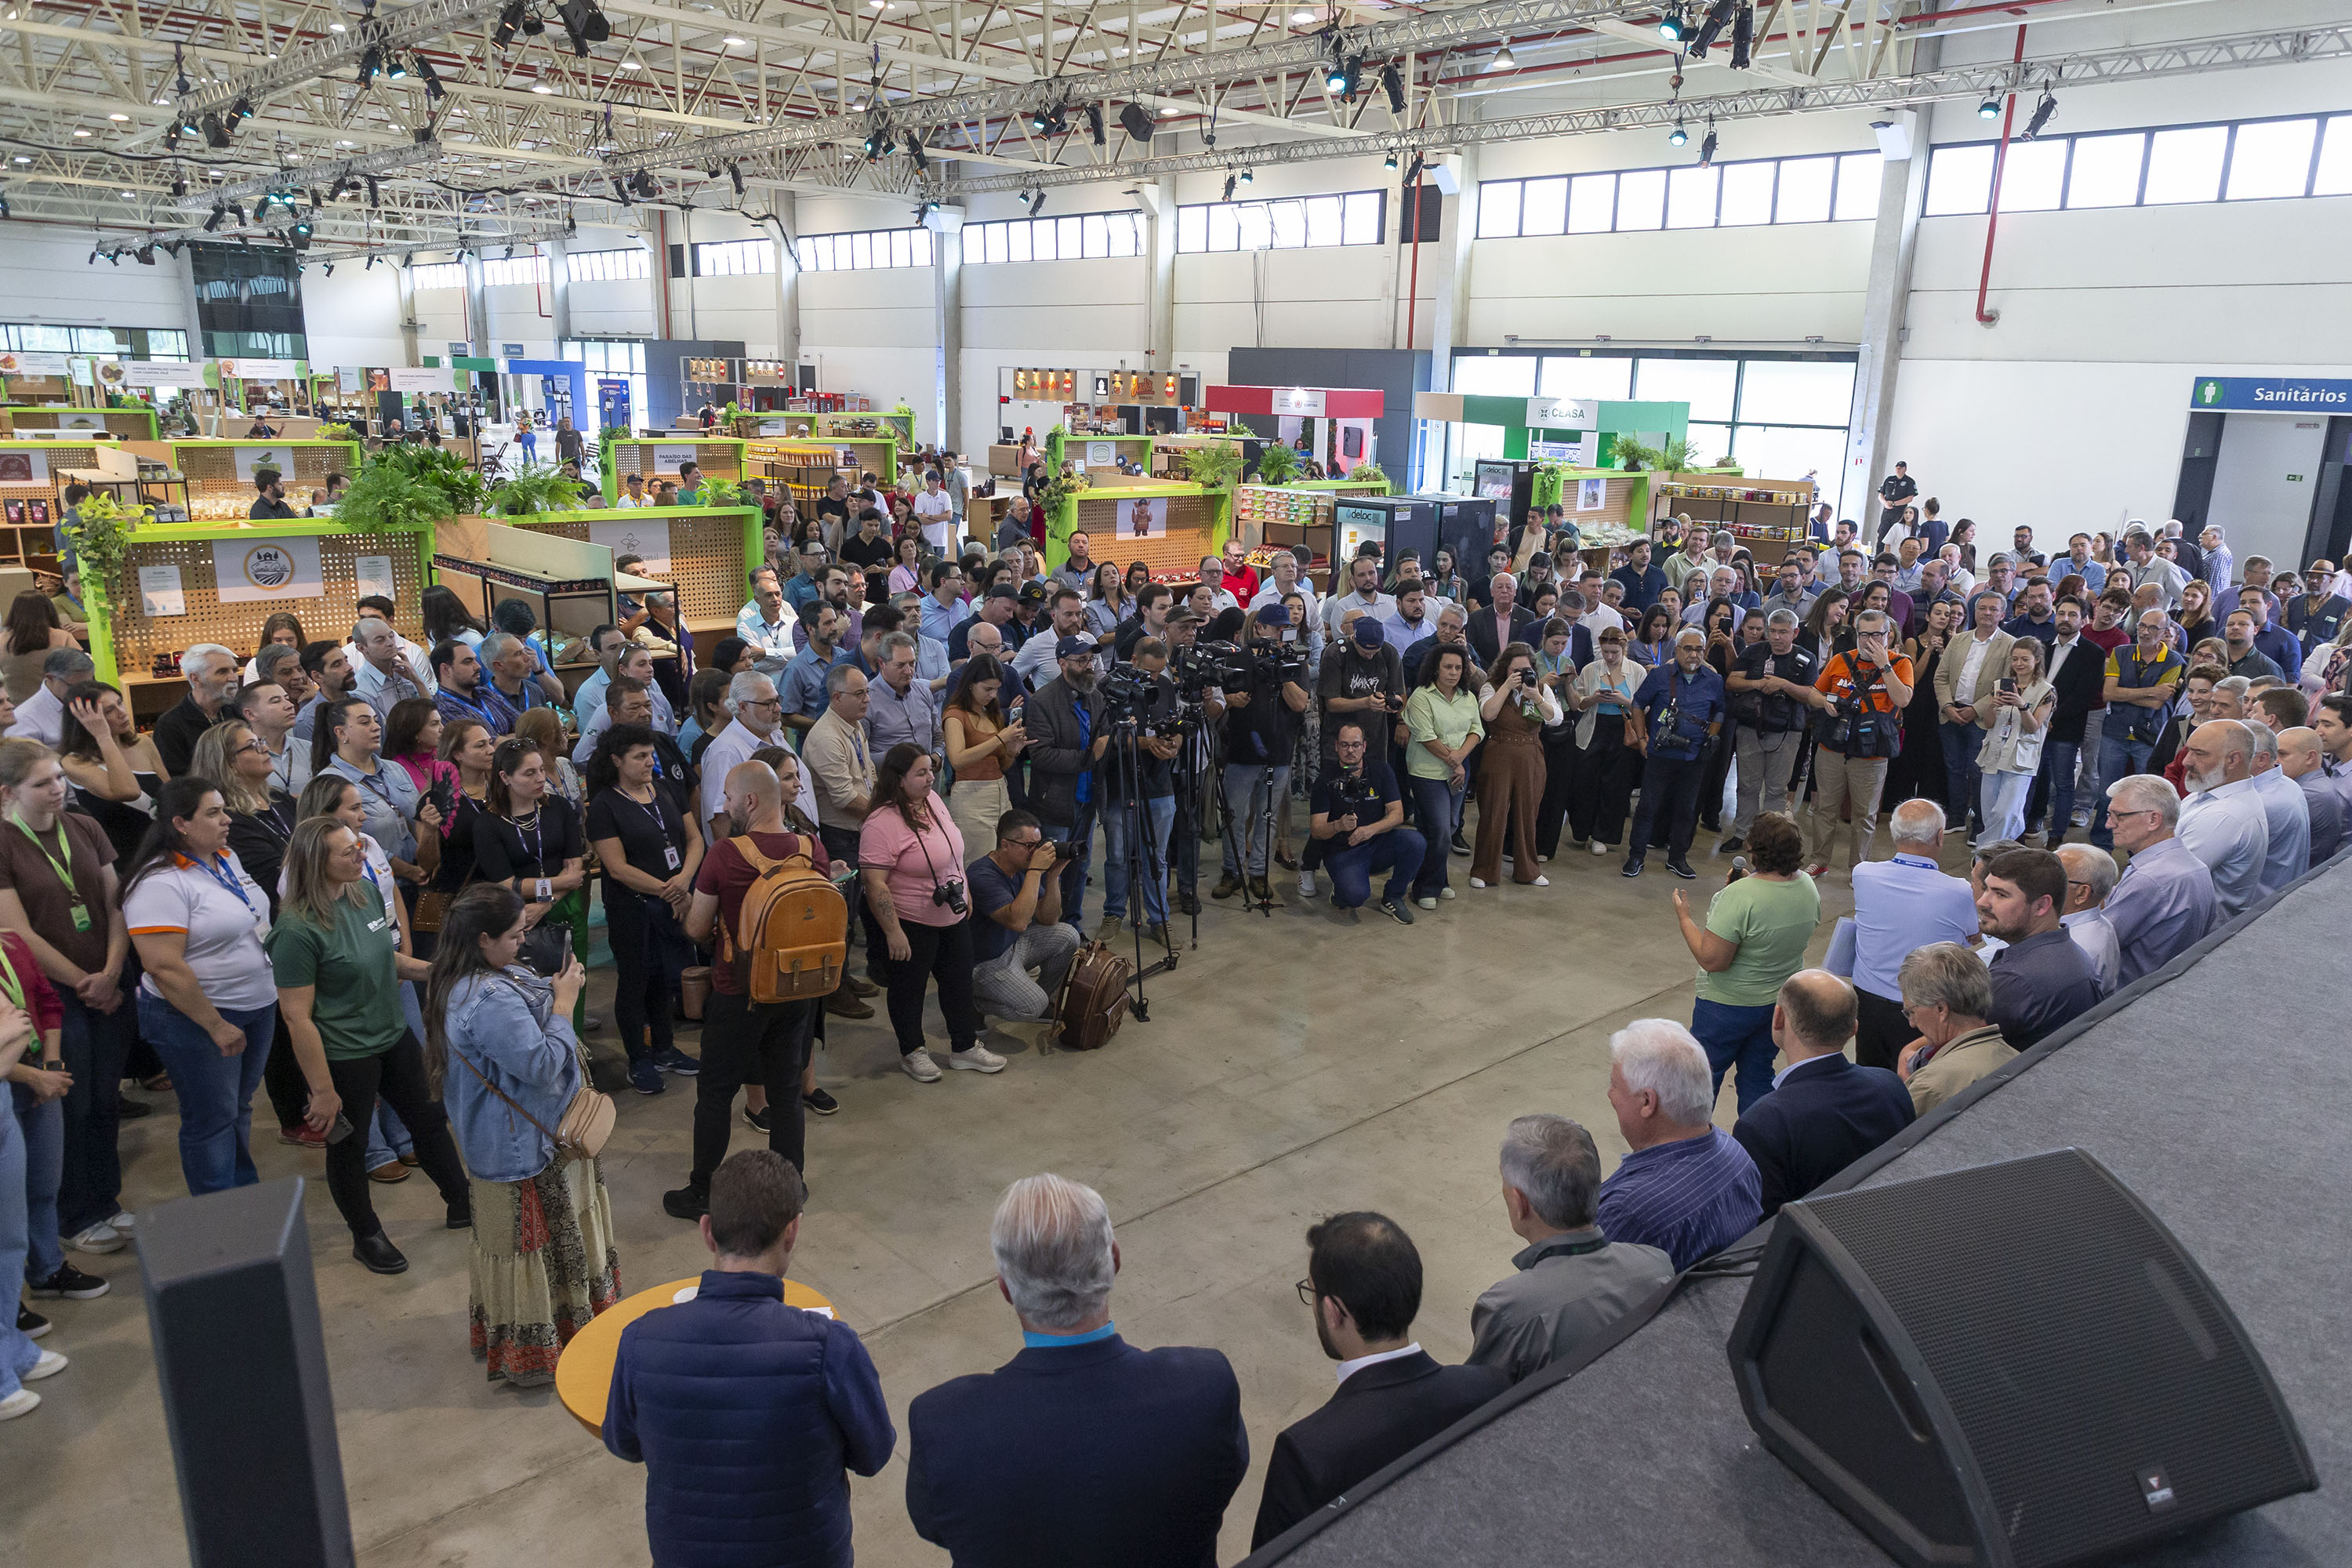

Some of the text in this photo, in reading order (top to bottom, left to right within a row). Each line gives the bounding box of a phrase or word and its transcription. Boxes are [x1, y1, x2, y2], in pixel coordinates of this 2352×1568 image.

[2254, 387, 2347, 403] Sanitários
[1552, 408, 1585, 419] CEASA
[1351, 509, 1372, 521] deloc
